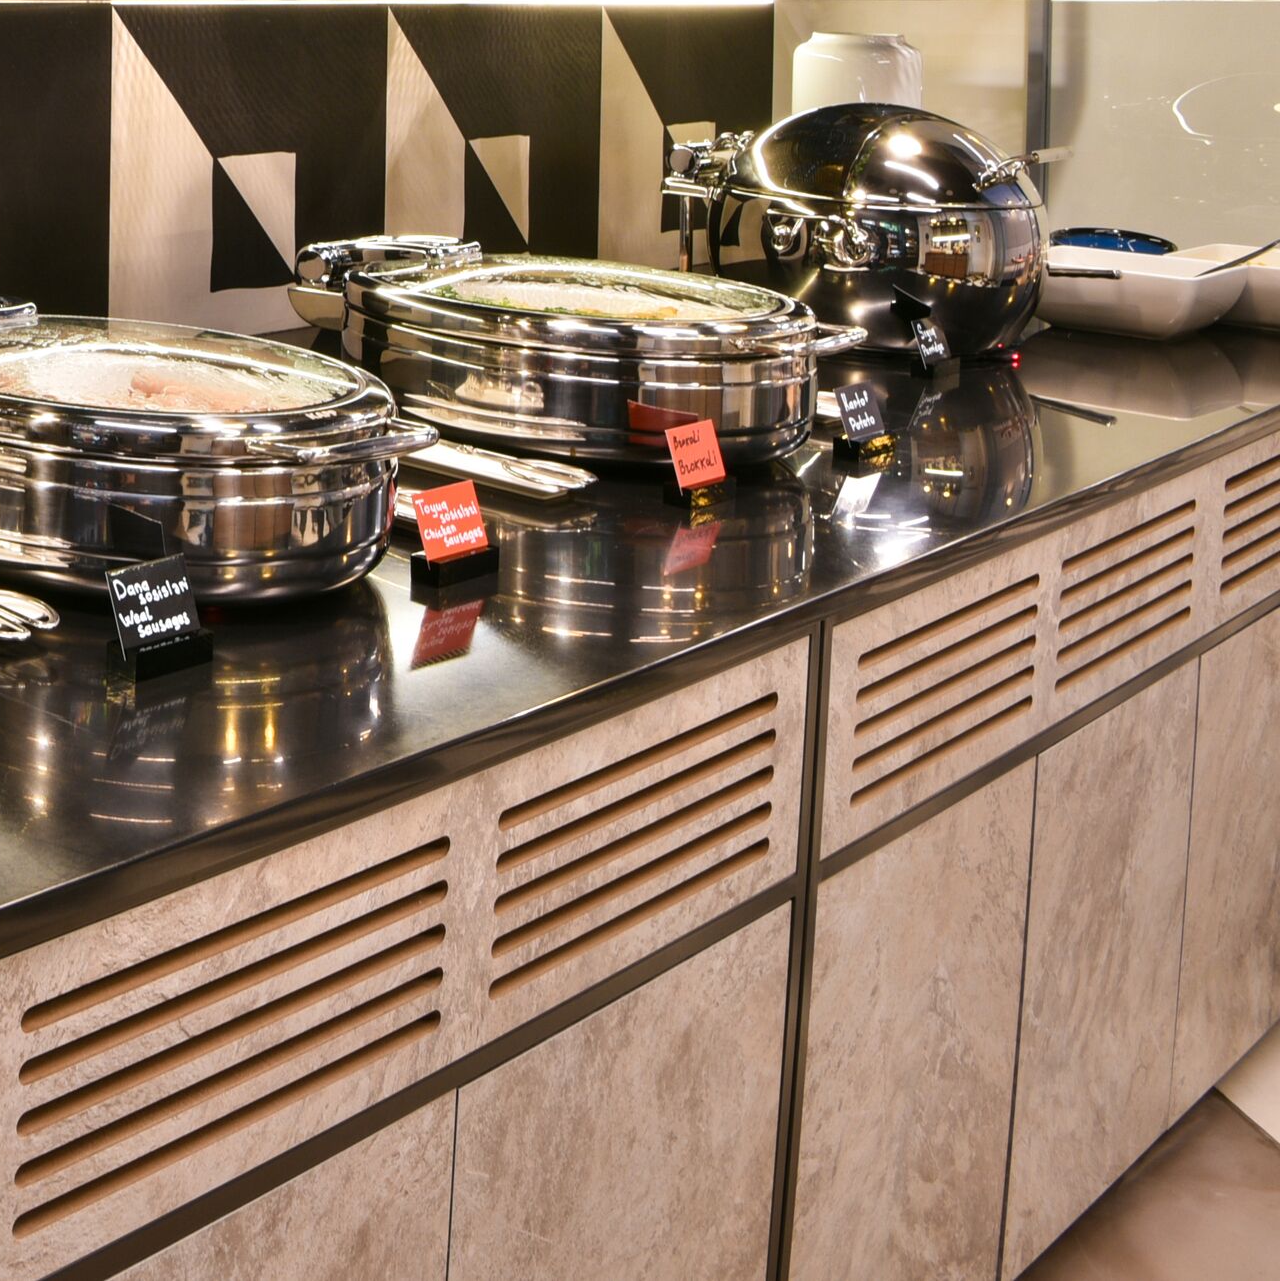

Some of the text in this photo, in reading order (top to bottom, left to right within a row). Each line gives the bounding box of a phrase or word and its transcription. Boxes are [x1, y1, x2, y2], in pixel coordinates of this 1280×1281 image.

[848, 412, 875, 432] Potato
[424, 525, 456, 540] Chicken
[113, 578, 150, 601] Dana
